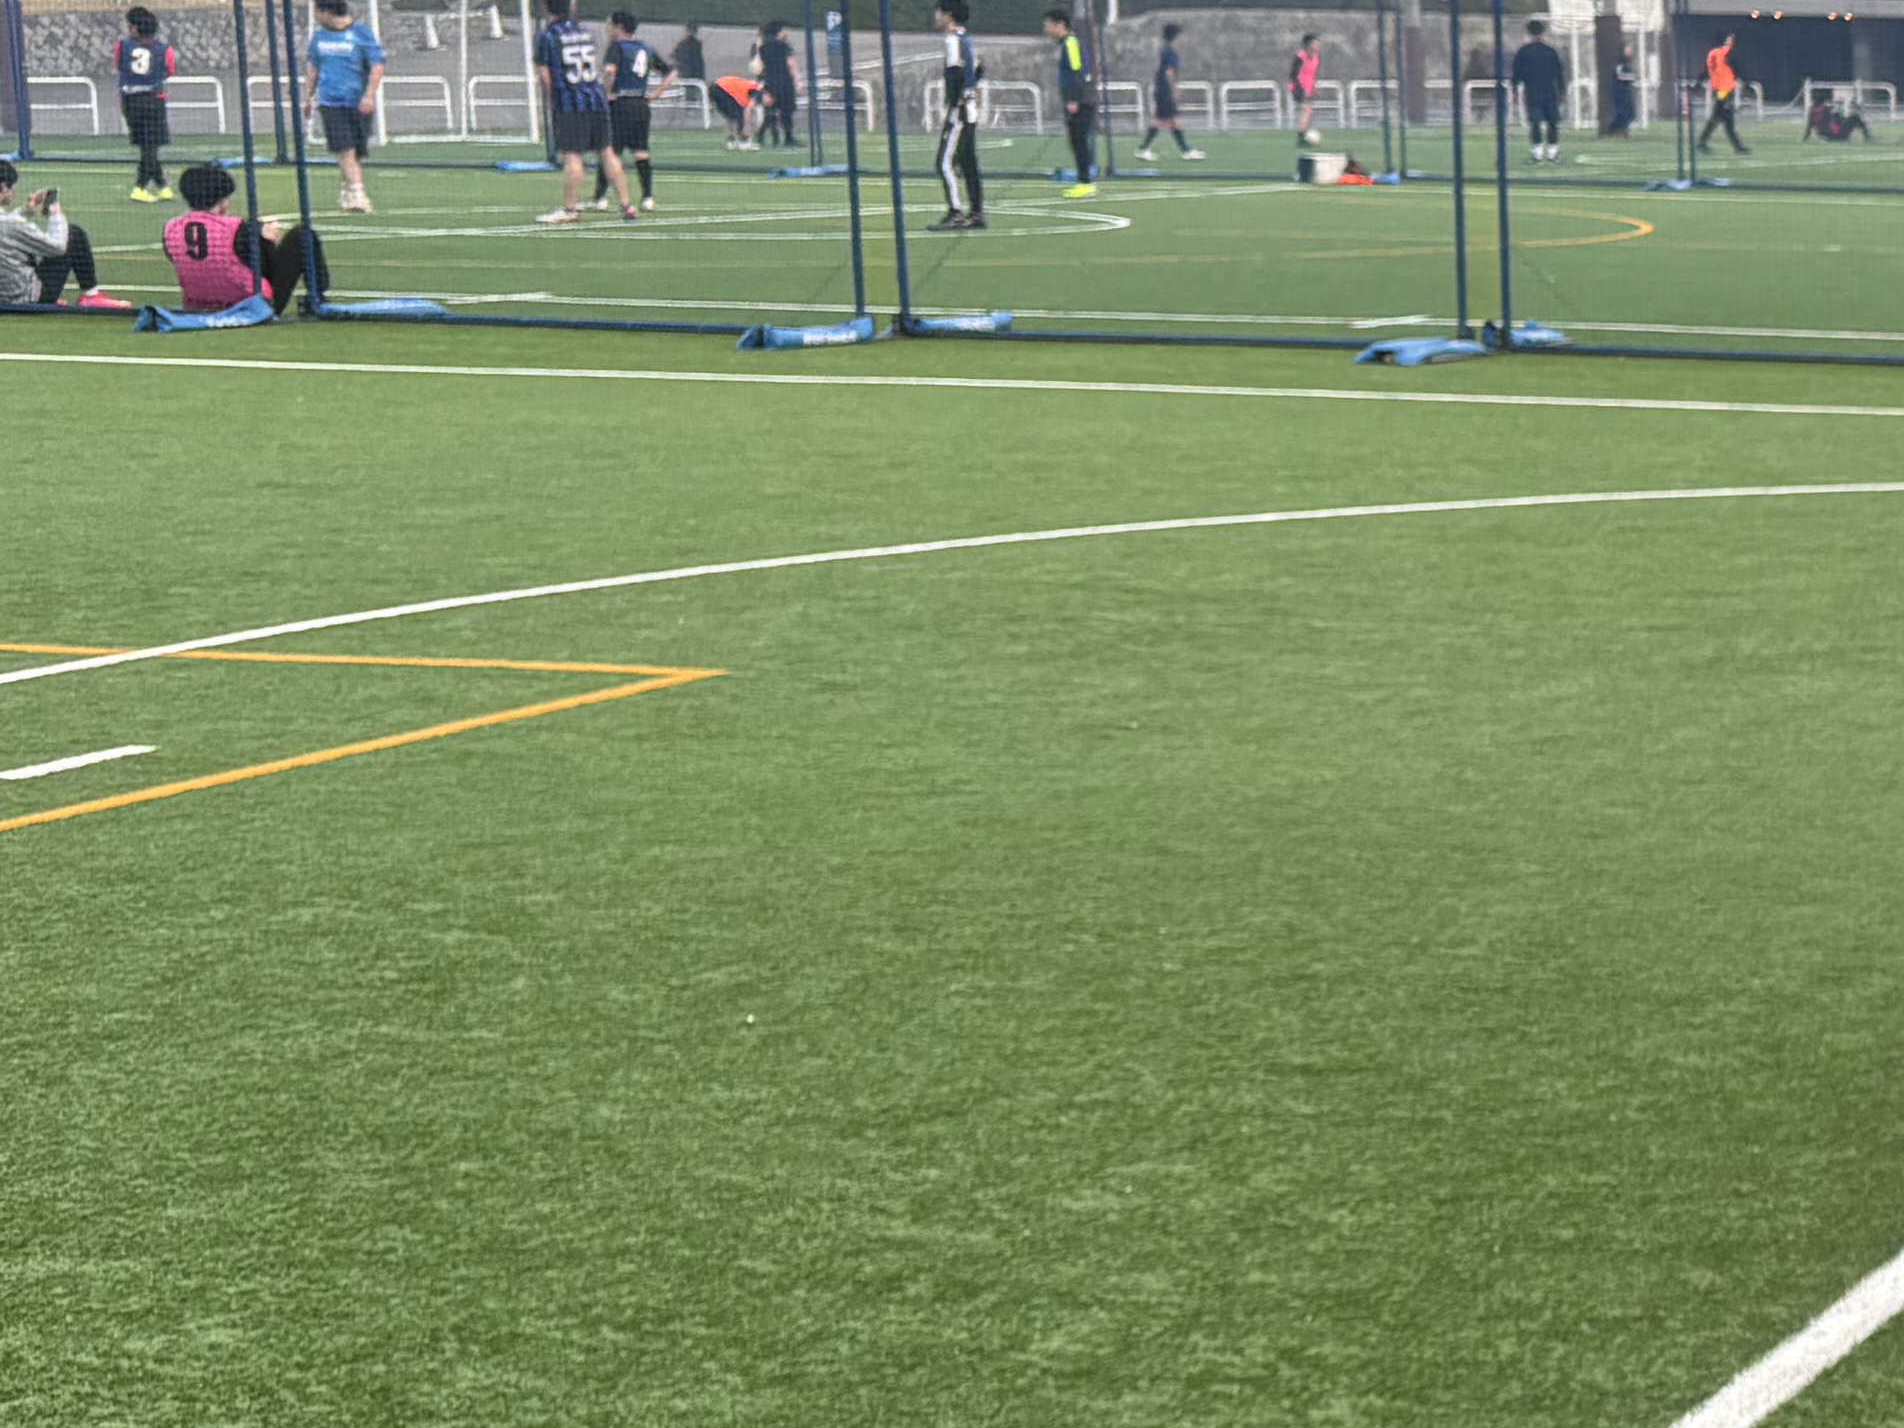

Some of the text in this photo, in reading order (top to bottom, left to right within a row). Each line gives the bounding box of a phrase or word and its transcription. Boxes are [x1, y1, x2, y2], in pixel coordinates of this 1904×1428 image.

[131, 47, 151, 75] 3
[562, 45, 597, 84] 55
[632, 49, 649, 78] 4
[184, 221, 209, 262] 9
